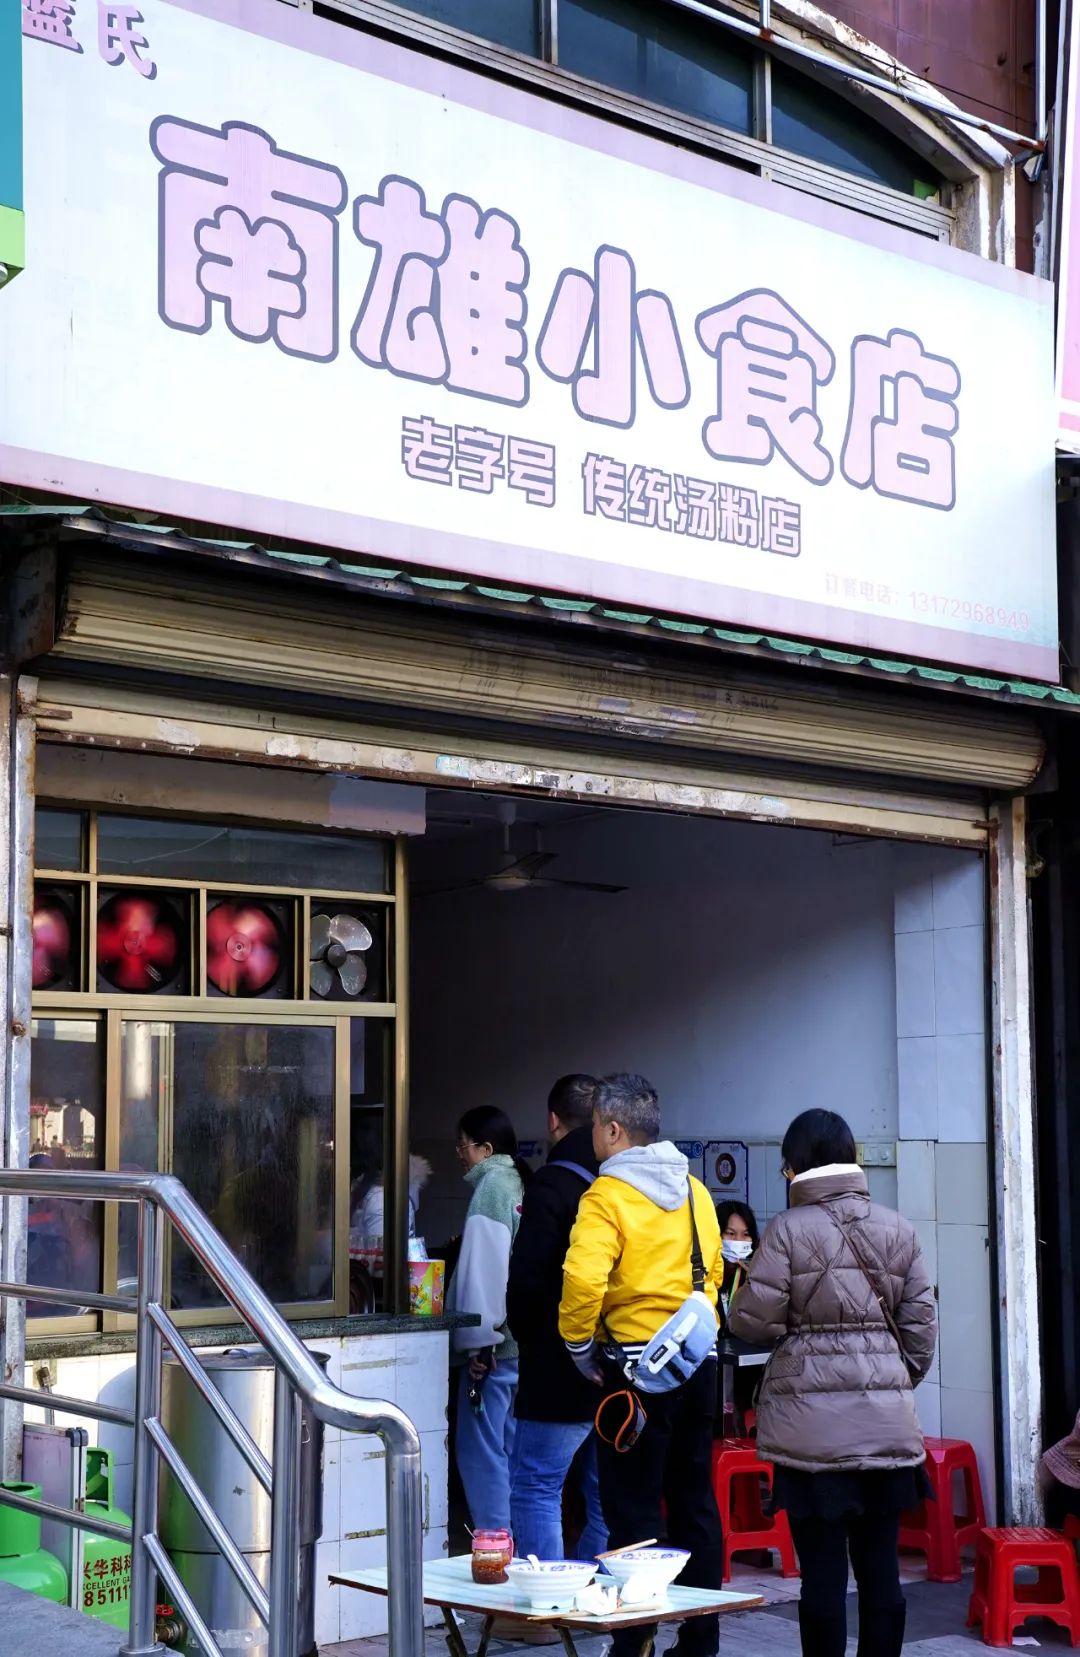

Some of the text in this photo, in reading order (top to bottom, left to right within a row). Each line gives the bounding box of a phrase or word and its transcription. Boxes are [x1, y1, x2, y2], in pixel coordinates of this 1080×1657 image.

[149, 114, 961, 511] 南雄小食店
[401, 415, 801, 557] 老字号 传统汤粉店
[909, 591, 1031, 632] 13172968949
